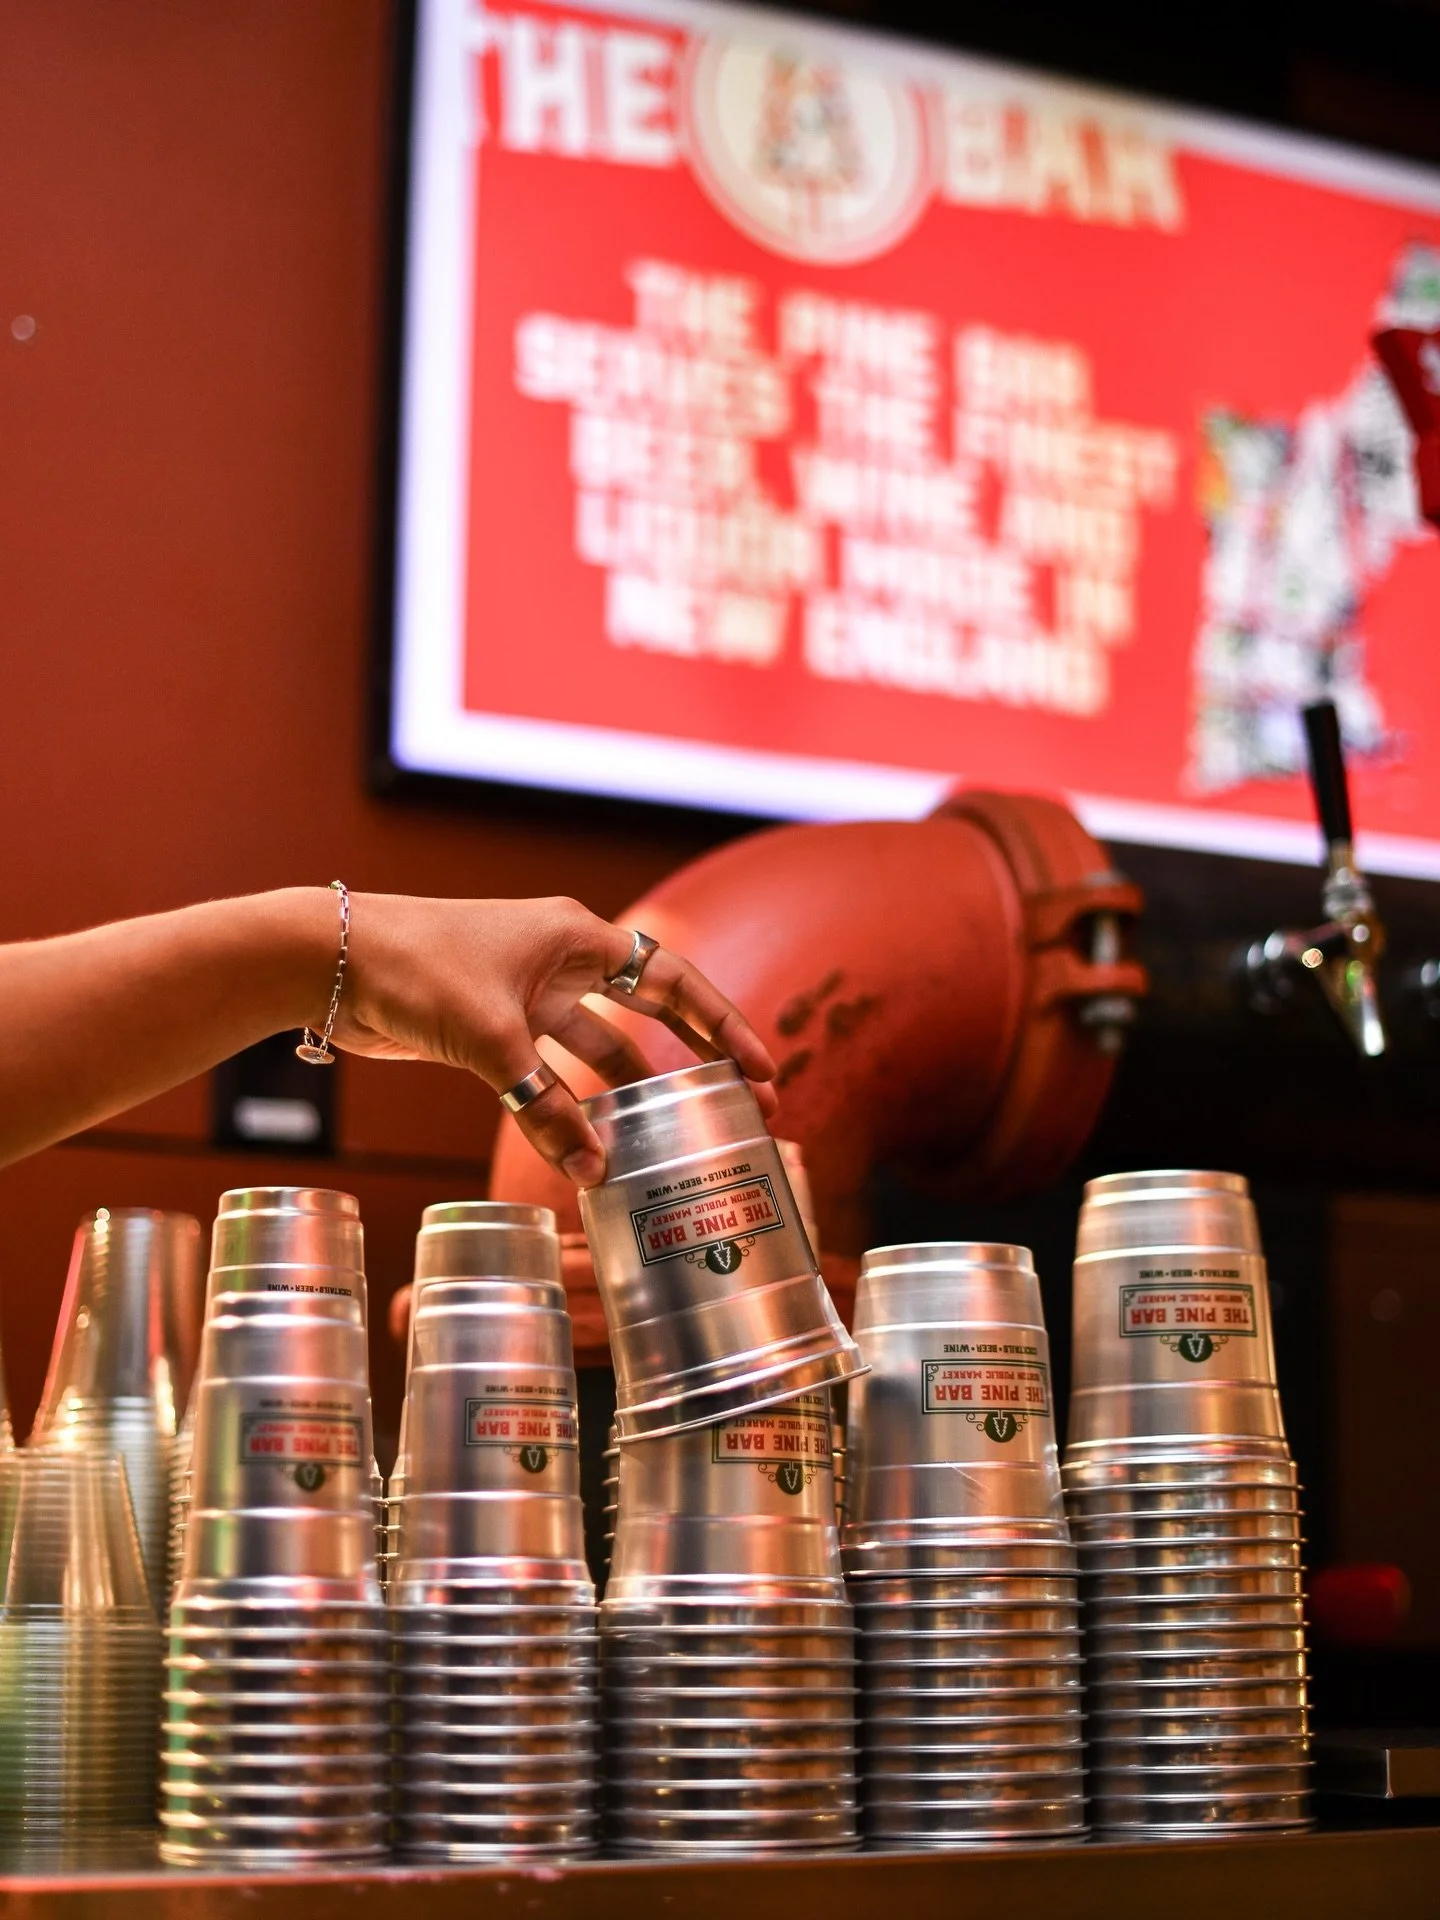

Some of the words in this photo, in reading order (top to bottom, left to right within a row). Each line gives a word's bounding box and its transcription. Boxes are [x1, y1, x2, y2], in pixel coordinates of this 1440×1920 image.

[708, 1163, 751, 1181] COCKTAILS
[679, 1177, 701, 1189] BEER
[646, 1185, 672, 1199] WINE
[730, 1189, 761, 1204] BOSTON
[695, 1198, 727, 1213] PUBLIC
[743, 1201, 773, 1223] THE
[651, 1208, 691, 1226] MARKET
[693, 1211, 738, 1236] PINE
[648, 1225, 686, 1251] BAR
[295, 1285, 314, 1293] BEER
[1137, 1295, 1176, 1304] MARKET
[1180, 1294, 1211, 1303] PUBLIC
[1131, 1308, 1166, 1324] BAR
[1175, 1308, 1216, 1322] PINE
[1223, 1308, 1249, 1324] THE
[944, 1344, 969, 1352] WINE
[976, 1344, 997, 1353] BEER
[942, 1371, 982, 1379] MARKET
[986, 1371, 1014, 1379] PUBLIC
[935, 1385, 972, 1400] BAR
[981, 1385, 1019, 1401] PINE
[1026, 1386, 1045, 1403] THE
[476, 1421, 510, 1435] BAR
[517, 1422, 550, 1436] PINE
[556, 1424, 572, 1438] THE
[734, 1419, 774, 1428] MARKET
[250, 1437, 284, 1452] BAR
[293, 1438, 329, 1454] PINE
[337, 1439, 358, 1455] THE
[726, 1433, 764, 1450] BAR
[773, 1435, 808, 1452] PINE
[814, 1439, 829, 1455] THE
